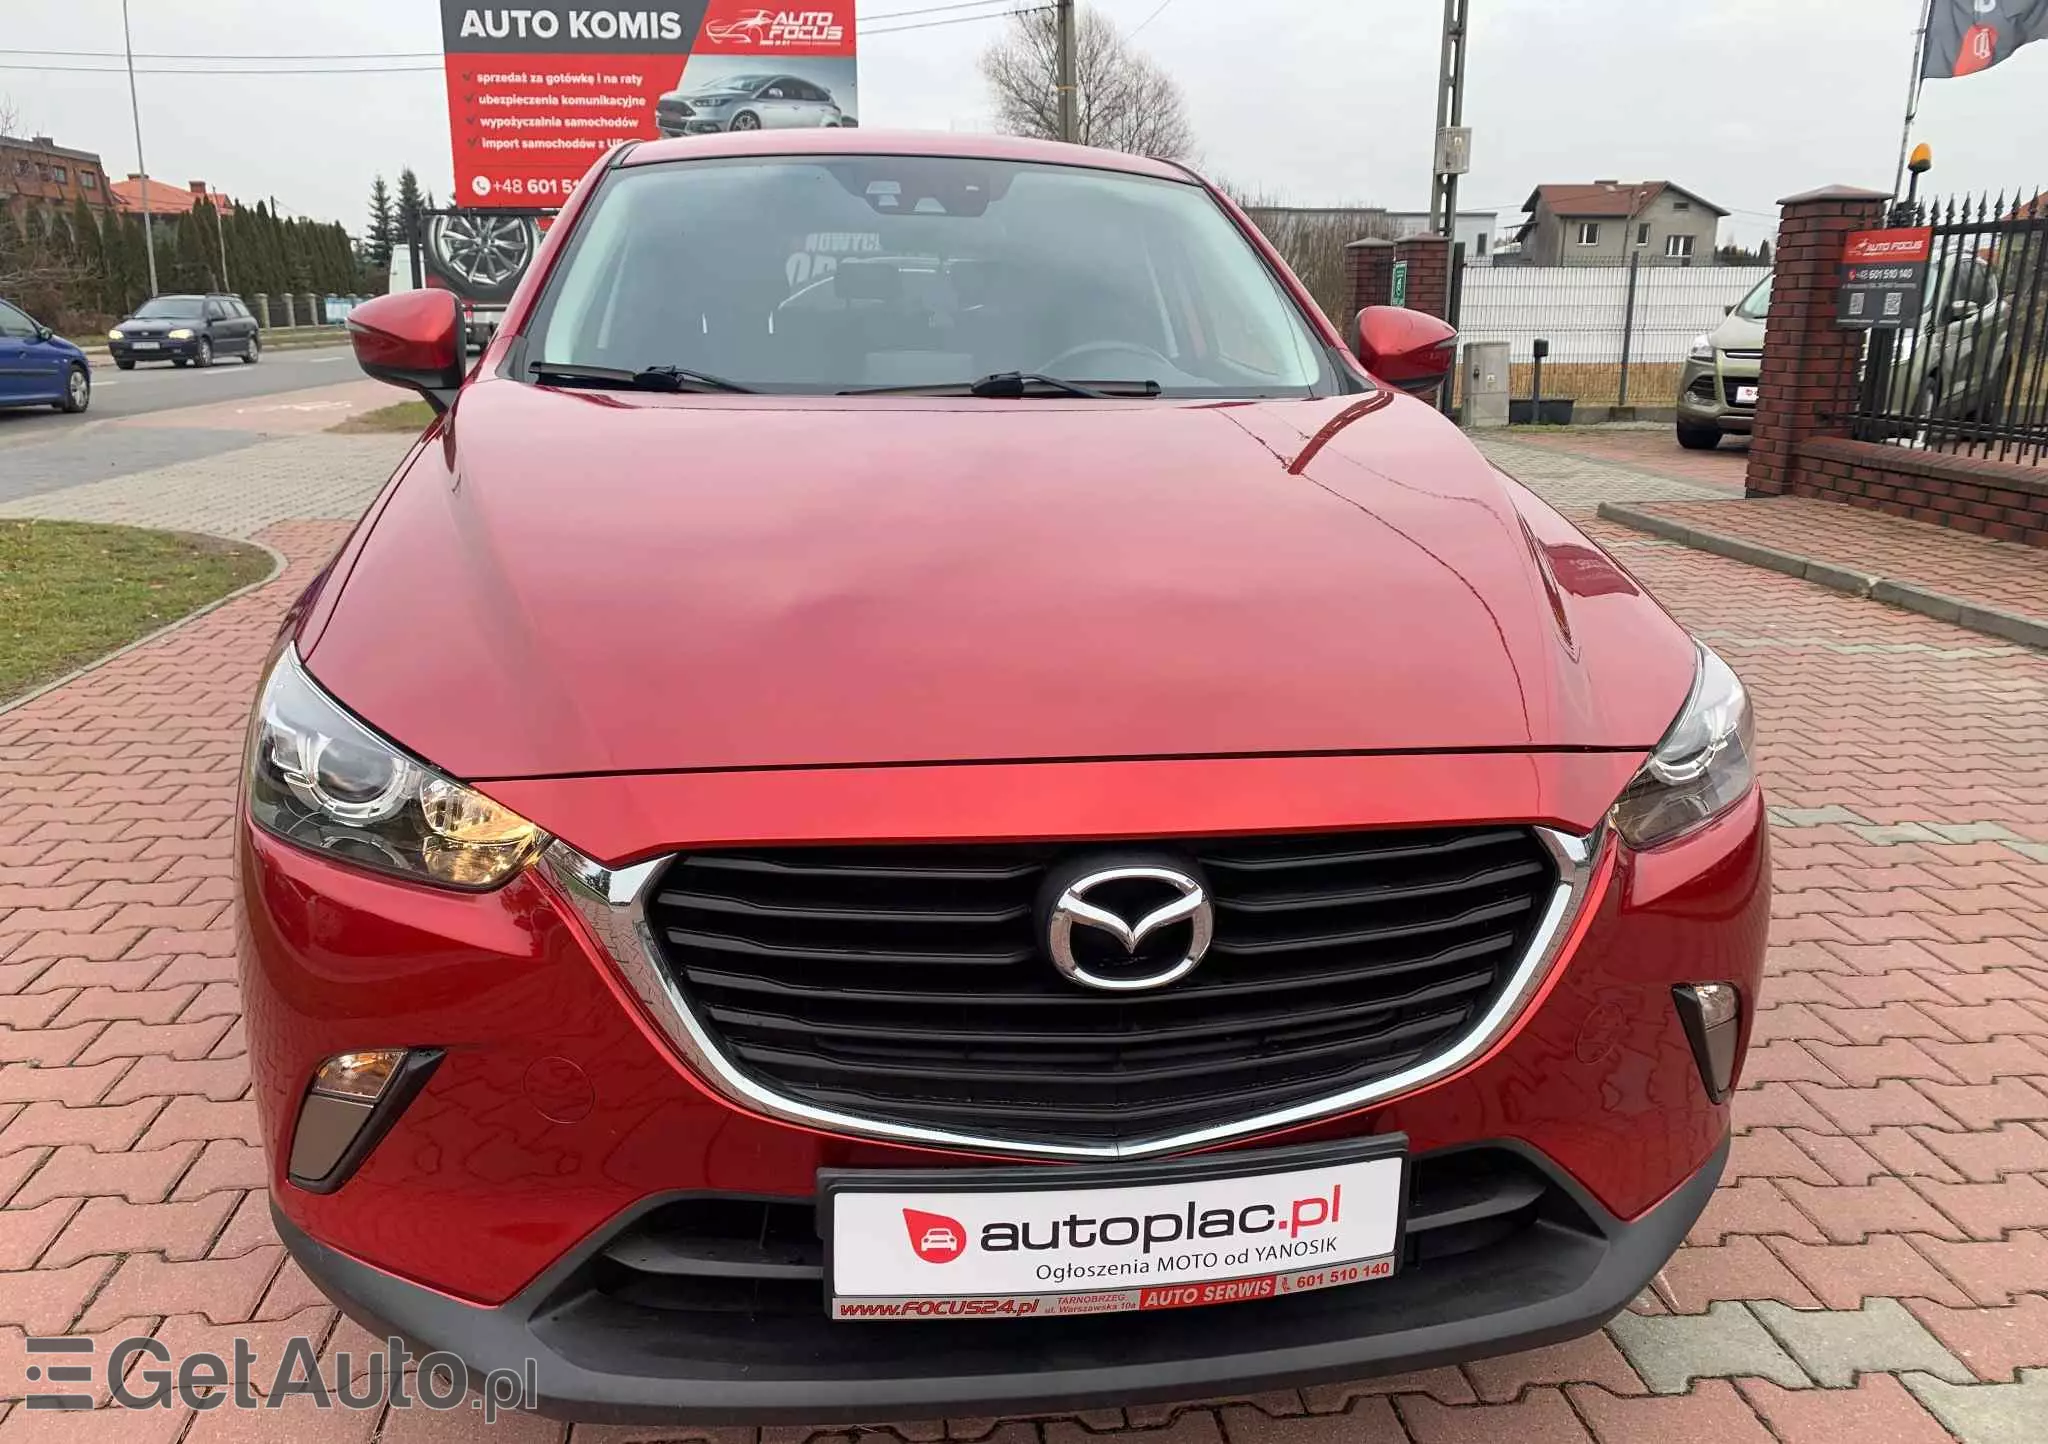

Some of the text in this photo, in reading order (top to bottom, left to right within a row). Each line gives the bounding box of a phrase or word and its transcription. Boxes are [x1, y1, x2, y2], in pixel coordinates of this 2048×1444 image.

[460, 9, 683, 40] AUTO KOMIS
[772, 12, 834, 26] AUTO
[768, 26, 844, 40] FOCUS
[476, 72, 528, 86] sprzedaż
[531, 74, 544, 84] za
[546, 72, 595, 86] gotówkę
[604, 75, 618, 84] na
[620, 74, 643, 87] raty
[478, 94, 646, 109] ubezpieczenia komunikacyjne
[480, 115, 639, 130] wypożyczalnia samochodów
[482, 137, 519, 150] import
[522, 137, 596, 149] samochodów
[598, 140, 605, 148] z
[493, 179, 523, 194] +48
[527, 179, 558, 194] 601
[1865, 240, 1924, 251] AUTO FOCUS
[980, 1184, 1341, 1254] autoplac.pl
[1036, 1236, 1338, 1284] Ogłoszenia MOTO od YANOSIK
[1296, 1262, 1390, 1289] 601 510 140
[1145, 1279, 1273, 1308] AUTO SERWIS
[840, 1298, 1040, 1317] www.FOCUS24.pl
[1059, 1303, 1118, 1313] Warszawska
